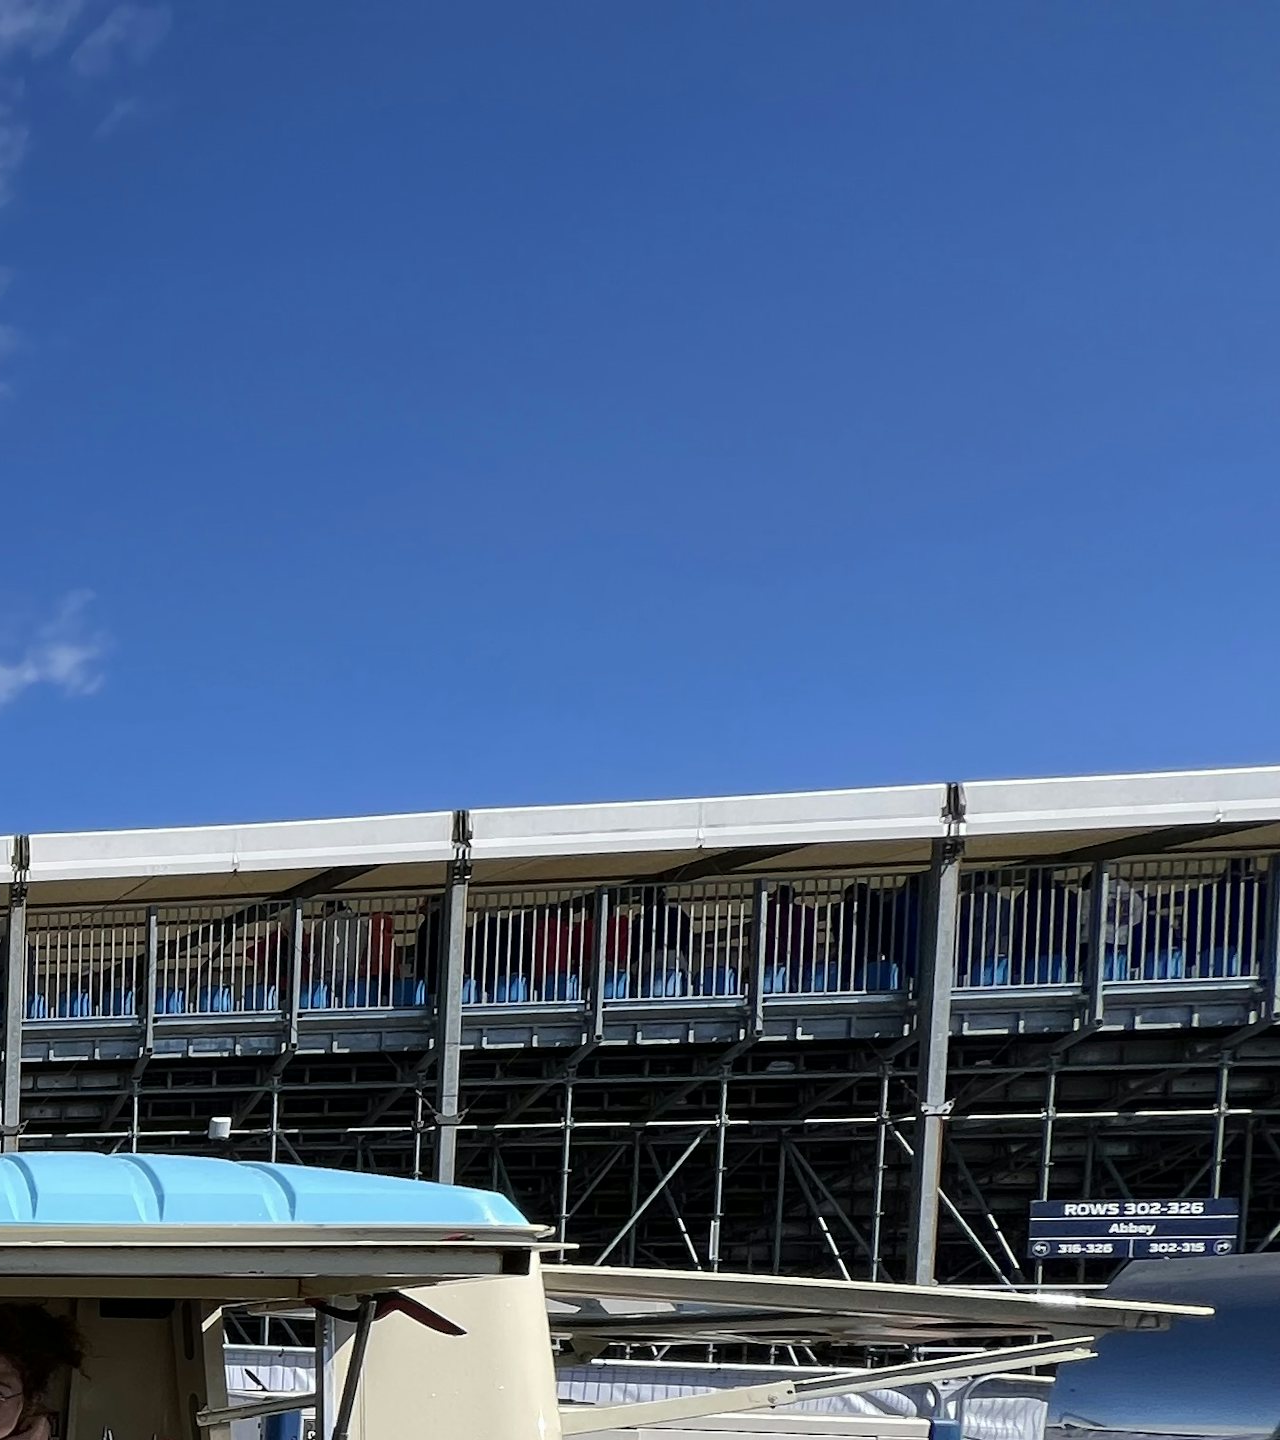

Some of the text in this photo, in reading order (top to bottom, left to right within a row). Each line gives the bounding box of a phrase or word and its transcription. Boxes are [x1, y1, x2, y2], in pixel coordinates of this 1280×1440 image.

[1063, 1202, 1204, 1216] ROWS 302-326
[1108, 1222, 1156, 1236] Abbey
[1148, 1242, 1206, 1254] 302-315
